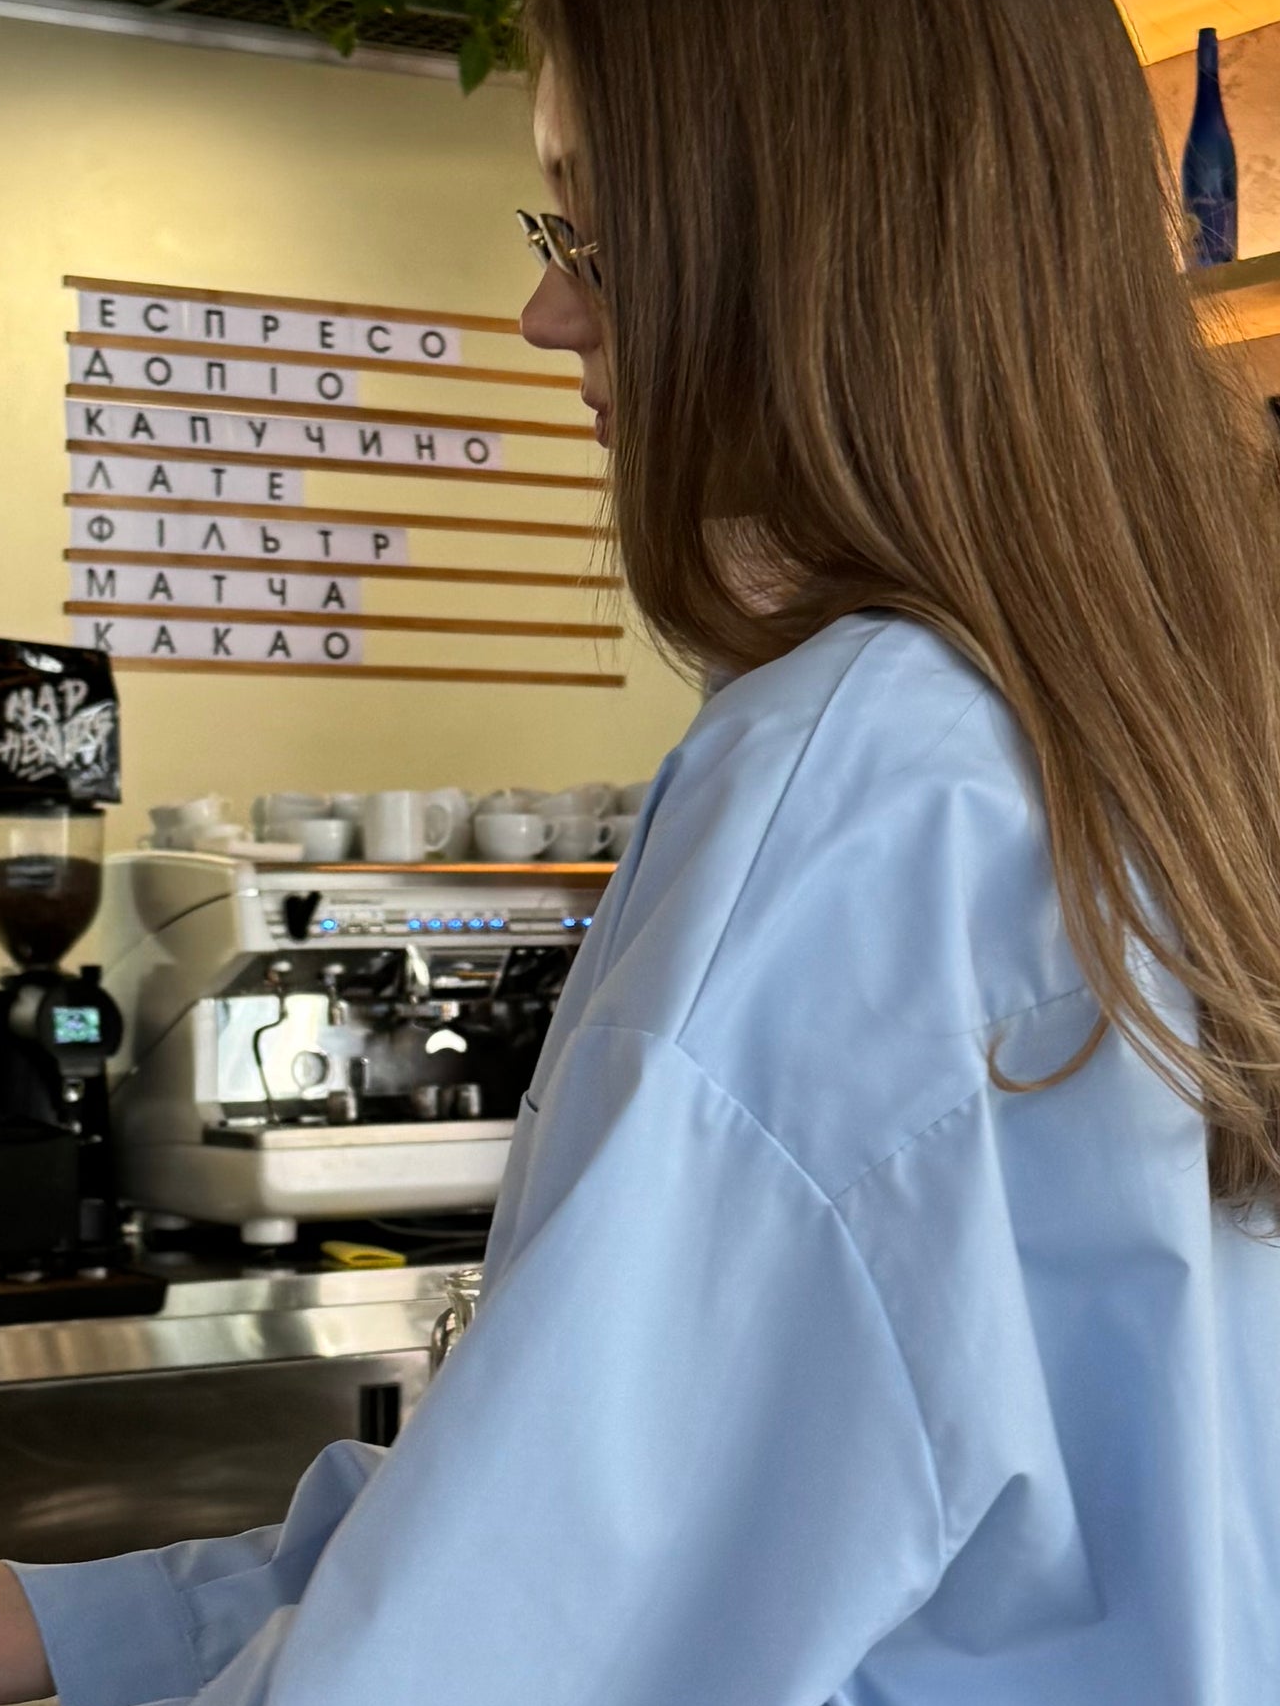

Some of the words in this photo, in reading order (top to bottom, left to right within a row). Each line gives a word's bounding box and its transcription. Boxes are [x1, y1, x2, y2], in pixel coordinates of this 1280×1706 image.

[99, 298, 446, 359] ЕСПРЕСО
[83, 349, 345, 401] ДОПІО
[85, 406, 490, 464] КАПУЧИНО
[87, 460, 283, 500] ЛАТЕ
[90, 514, 390, 563] ФІЛЬТР
[87, 568, 346, 610] МАТЧА
[93, 622, 349, 660] КАКАО
